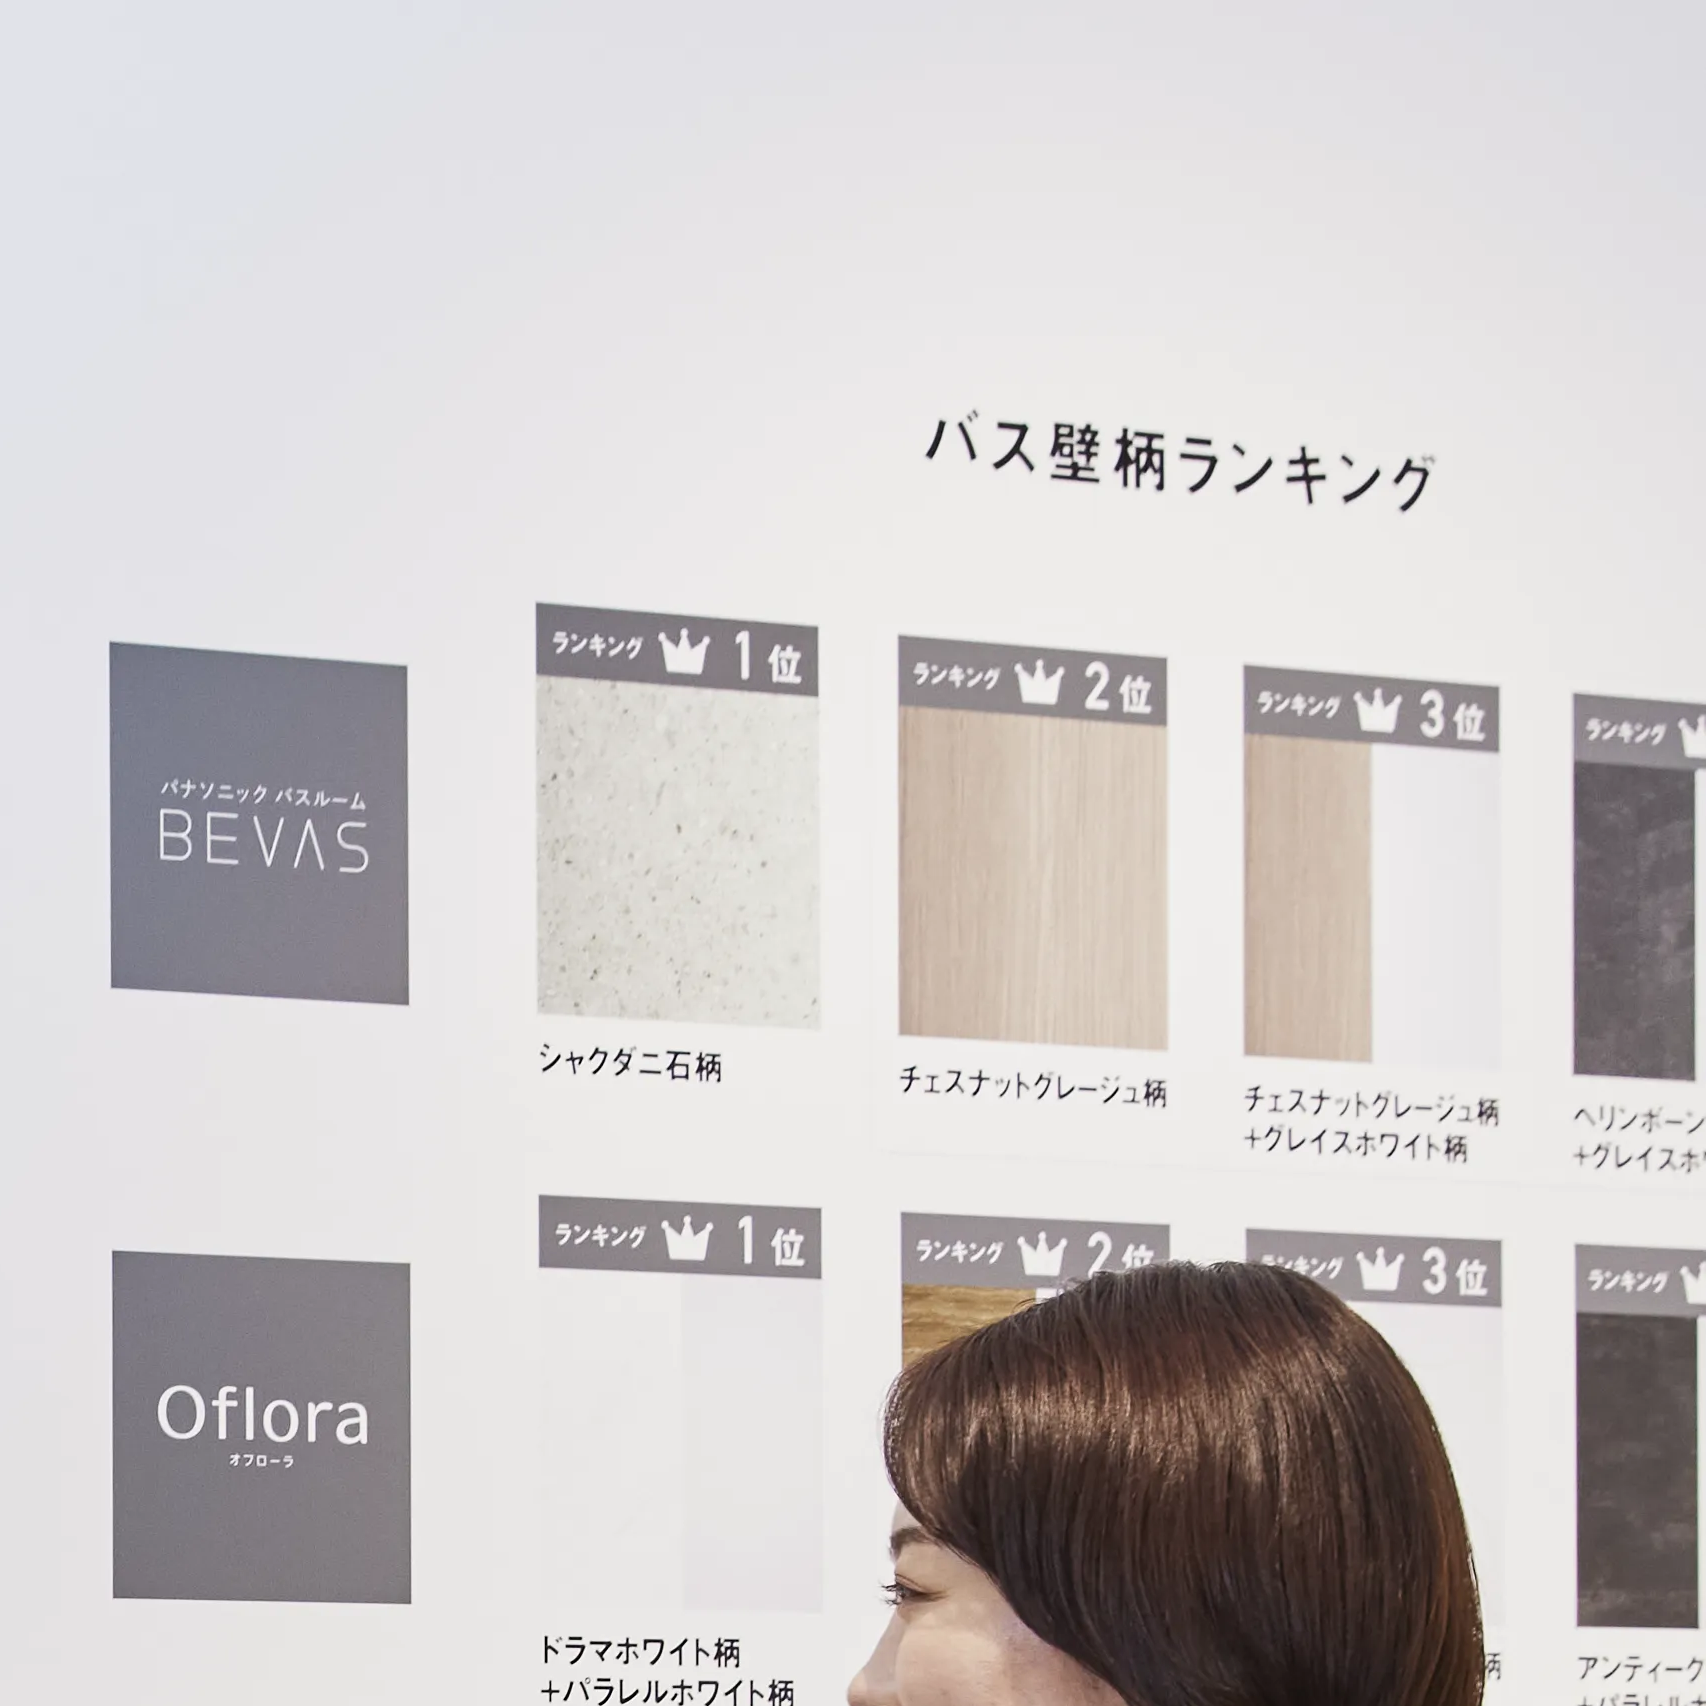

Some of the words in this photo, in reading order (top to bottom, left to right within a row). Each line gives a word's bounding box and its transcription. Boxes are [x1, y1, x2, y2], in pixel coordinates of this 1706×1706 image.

[924, 409, 1438, 513] バス壁柄ランキング
[552, 630, 643, 660] ランキング
[734, 630, 802, 683] 1位
[913, 661, 1002, 691] ランキング
[1083, 660, 1153, 715] 2位
[1257, 690, 1341, 720] ランキング
[1420, 689, 1487, 742] 3位
[1585, 717, 1667, 746] ランキング
[160, 778, 268, 804] パナソニック
[275, 788, 367, 811] バスルーム
[538, 1043, 722, 1084] シャクダニ石柄
[899, 1065, 1168, 1110] チェスナットグレージュ柄
[1244, 1085, 1500, 1128] チェスナットグレージュ柄
[1573, 1141, 1706, 1174] +グレイスホ
[555, 1222, 648, 1251] ランキング
[737, 1215, 806, 1269] 1位
[915, 1237, 1005, 1264] ランキング
[1421, 1246, 1488, 1298] 3位
[1587, 1267, 1670, 1293] ランキング
[156, 1383, 369, 1446] Oflora
[228, 1452, 295, 1470] オフローラ
[540, 1634, 742, 1670] ドラマホワイト柄
